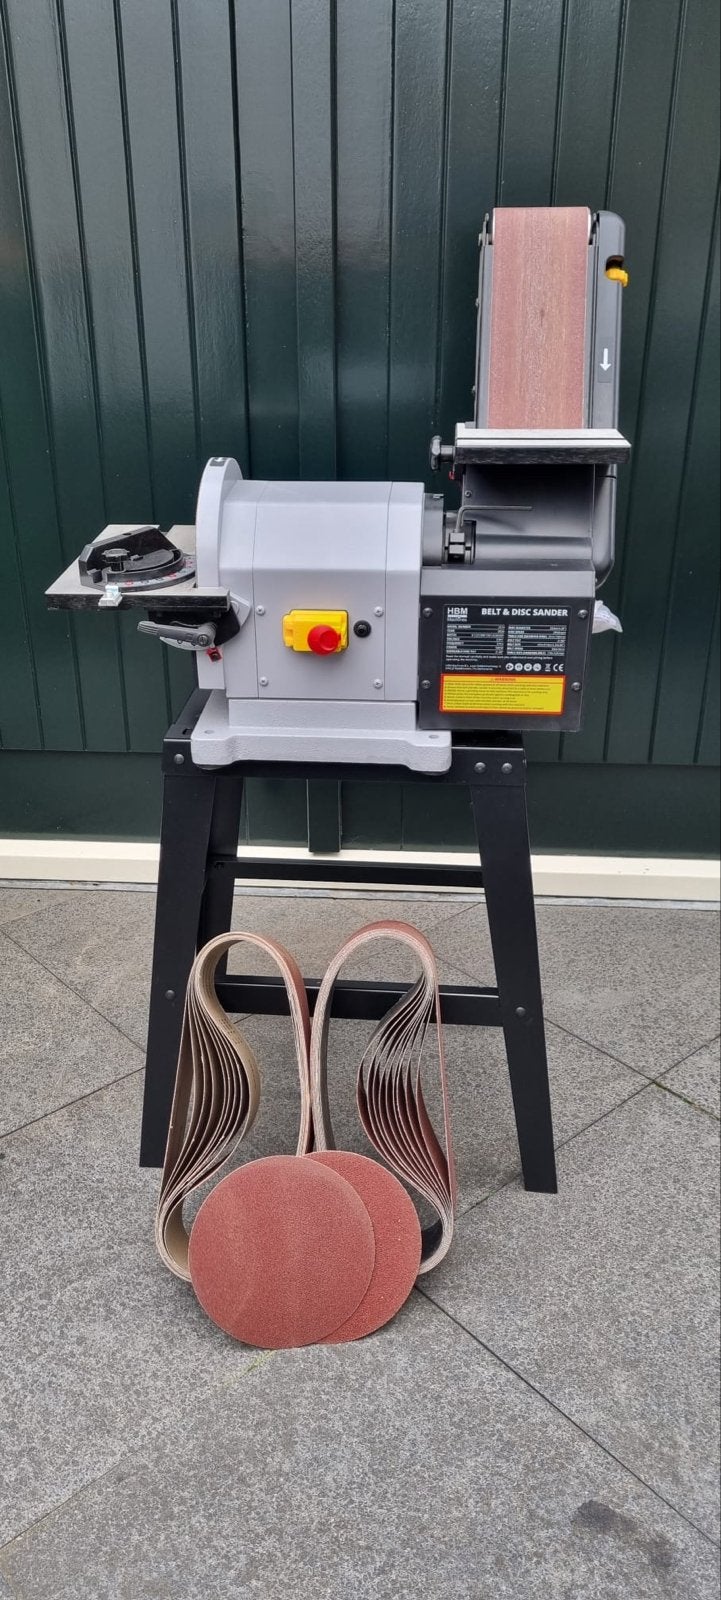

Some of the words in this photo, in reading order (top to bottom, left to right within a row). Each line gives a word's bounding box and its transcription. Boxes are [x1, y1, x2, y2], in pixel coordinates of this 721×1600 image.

[481, 608, 501, 616] BELT
[502, 608, 510, 616] &
[512, 608, 531, 616] DISC
[533, 608, 568, 617] SANDER
